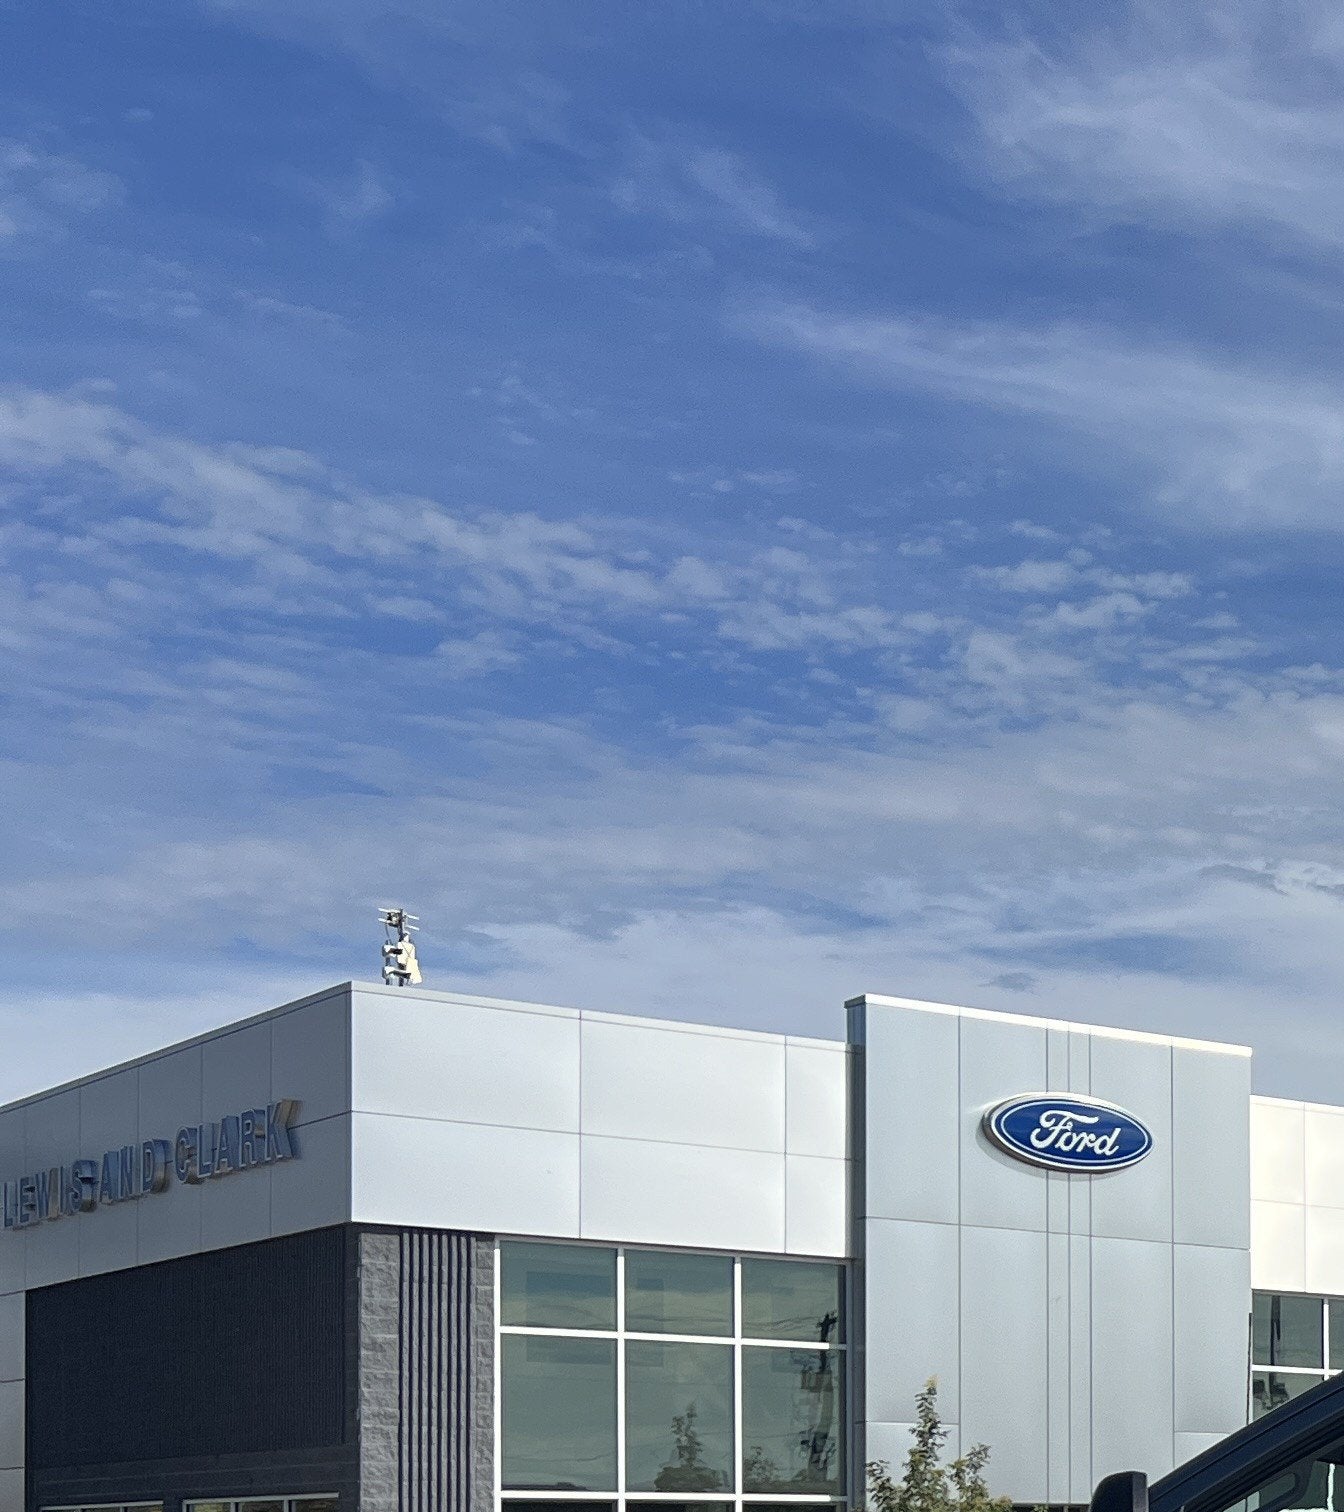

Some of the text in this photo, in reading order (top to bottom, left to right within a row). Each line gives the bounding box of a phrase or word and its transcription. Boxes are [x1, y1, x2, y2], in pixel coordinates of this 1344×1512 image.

[3, 1099, 302, 1228] LEWIS AND CLARK
[1030, 1110, 1121, 1156] Ford
